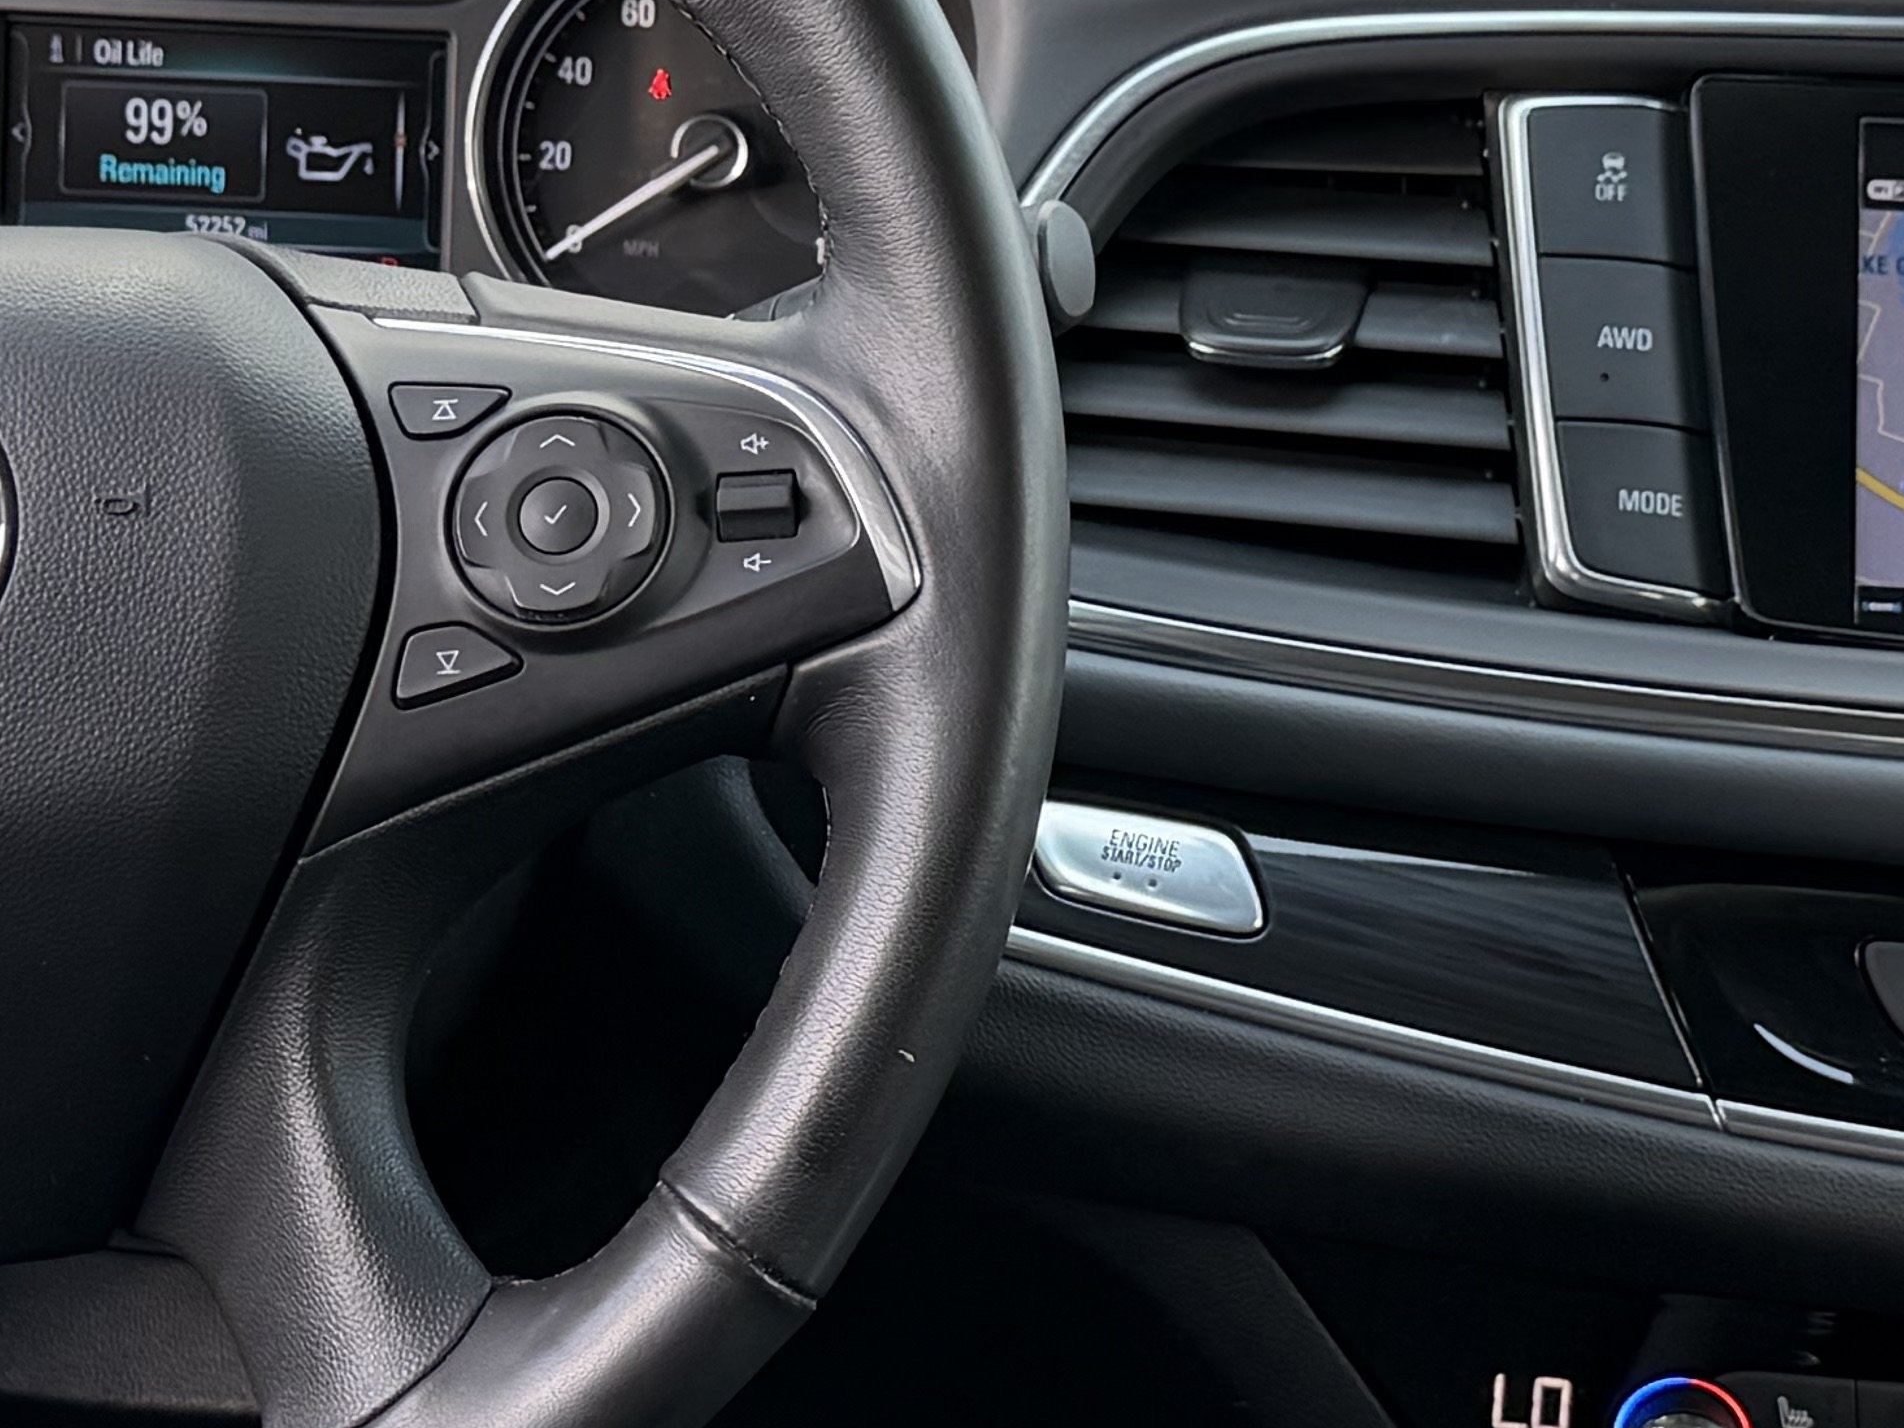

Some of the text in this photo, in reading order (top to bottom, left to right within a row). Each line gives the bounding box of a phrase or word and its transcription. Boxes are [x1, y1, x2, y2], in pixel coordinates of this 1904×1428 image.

[94, 39, 165, 68] Oil Life
[557, 56, 593, 86] 40
[125, 97, 208, 145] 99%
[538, 141, 572, 170] 20
[99, 154, 226, 194] Remaining
[1595, 184, 1628, 202] OFF
[1597, 325, 1653, 352] AWD
[1617, 488, 1684, 518] MODE
[1109, 829, 1180, 858] ENGINE
[1101, 845, 1182, 873] START/STOP
